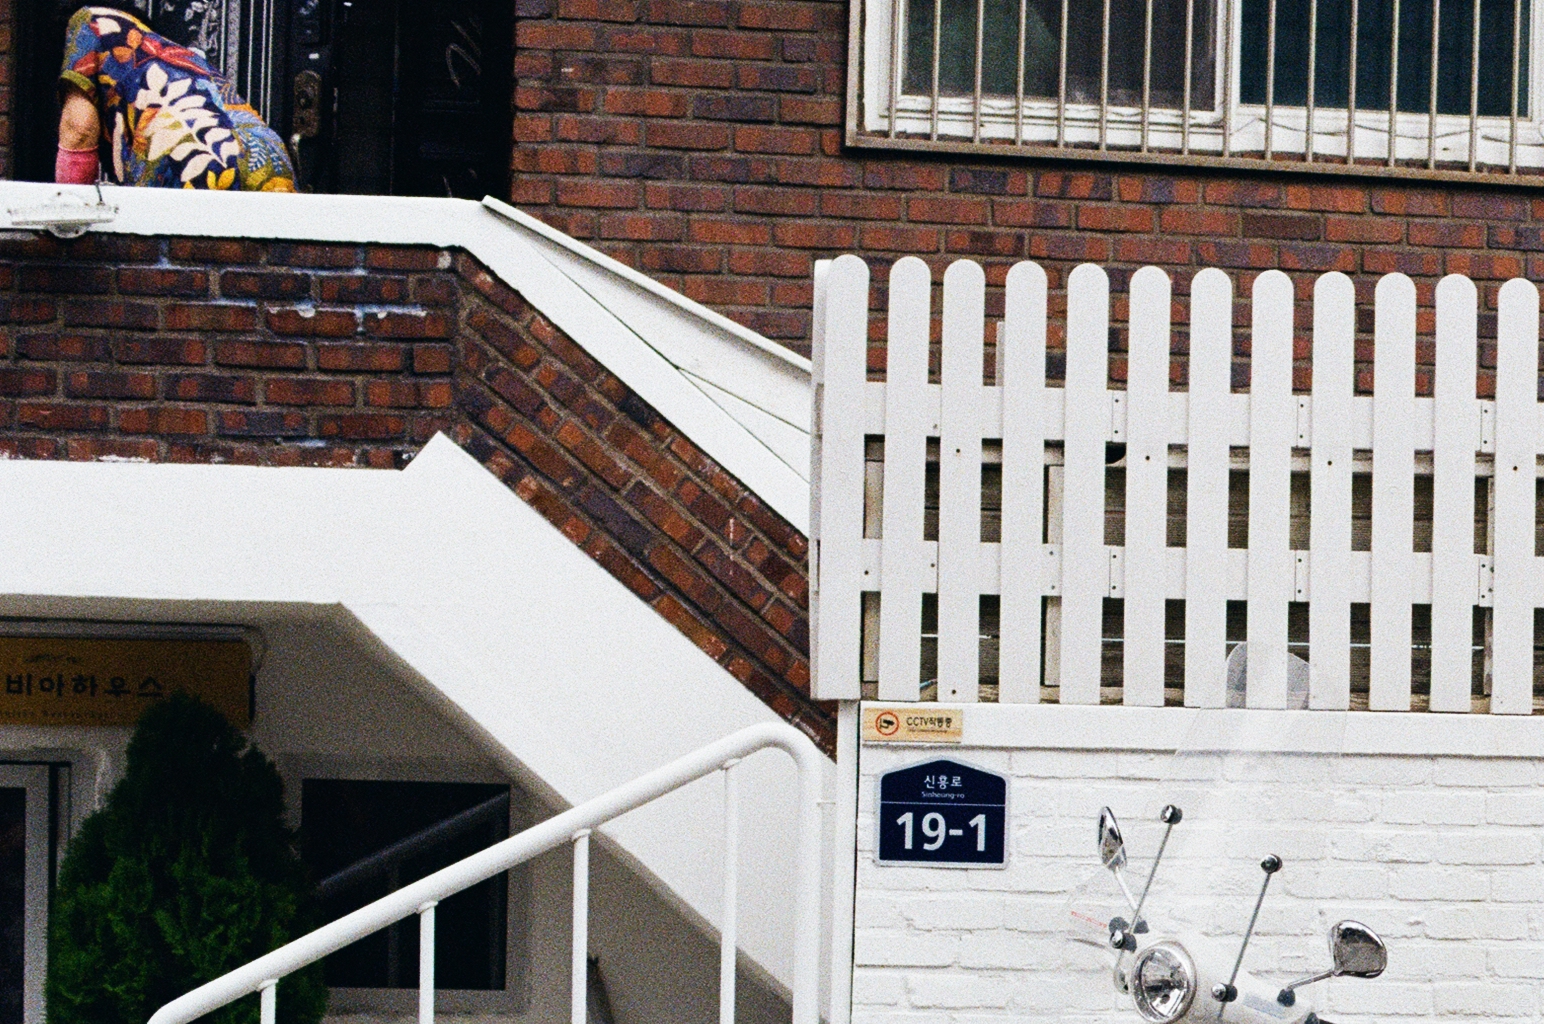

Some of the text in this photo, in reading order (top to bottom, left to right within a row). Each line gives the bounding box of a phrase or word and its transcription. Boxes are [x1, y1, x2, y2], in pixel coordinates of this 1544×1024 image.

[5, 672, 164, 698] 비아하우스
[923, 774, 963, 790] 신흥로
[921, 790, 966, 800] Sinheung-ro
[896, 811, 987, 852] 19-1
